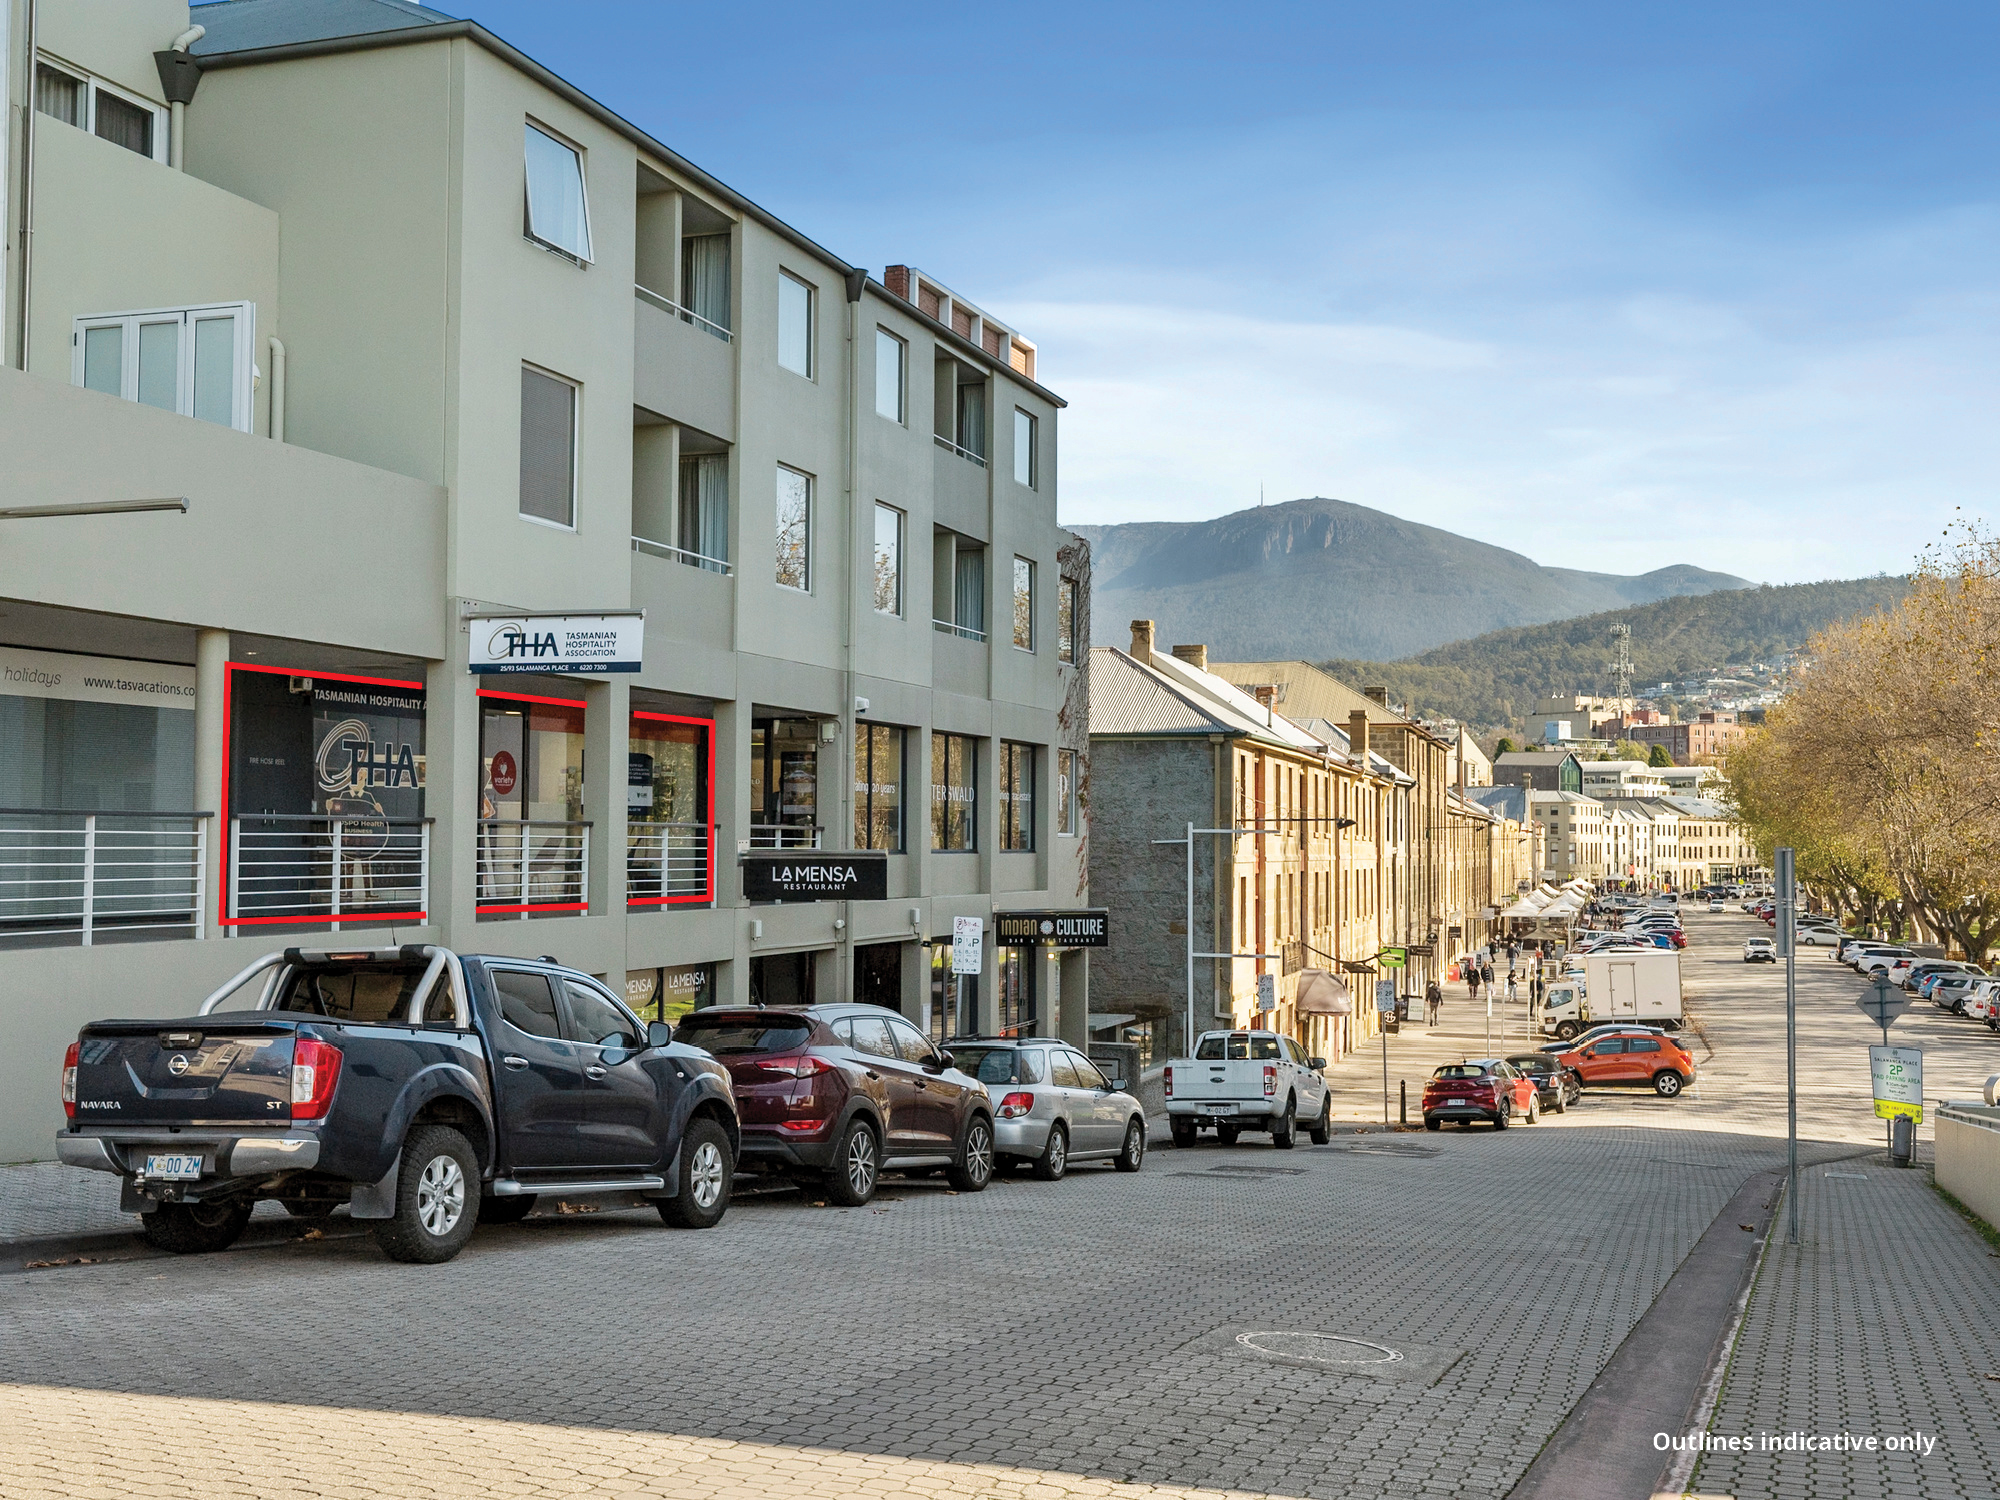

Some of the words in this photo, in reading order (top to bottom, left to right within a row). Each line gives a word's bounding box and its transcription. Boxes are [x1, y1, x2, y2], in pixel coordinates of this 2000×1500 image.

[566, 632, 617, 640] TASMANIAN
[503, 632, 559, 657] THA
[566, 640, 617, 648] HOSPITALITY
[565, 649, 616, 657] ASSOCIATION
[515, 664, 551, 672] SALAMANCA
[4, 666, 62, 688] holidays
[314, 689, 367, 704] TASMANIAN
[369, 696, 421, 710] HOSPITALITY
[260, 757, 273, 765] HOSE
[275, 758, 285, 766] REEL
[342, 738, 419, 790] THA
[872, 782, 880, 793] 20
[880, 784, 896, 796] years
[772, 866, 793, 882] LA
[795, 866, 857, 882] MENSA
[1056, 919, 1103, 936] CULTURE
[679, 971, 705, 987] MENSA
[674, 987, 701, 995] RESTAURANT
[1889, 1064, 1903, 1075] 2P
[1886, 1075, 1906, 1083] PARKING
[80, 1101, 121, 1110] NAVARA
[267, 1101, 282, 1110] ST
[147, 1158, 156, 1173] K
[185, 1158, 200, 1173] ZM
